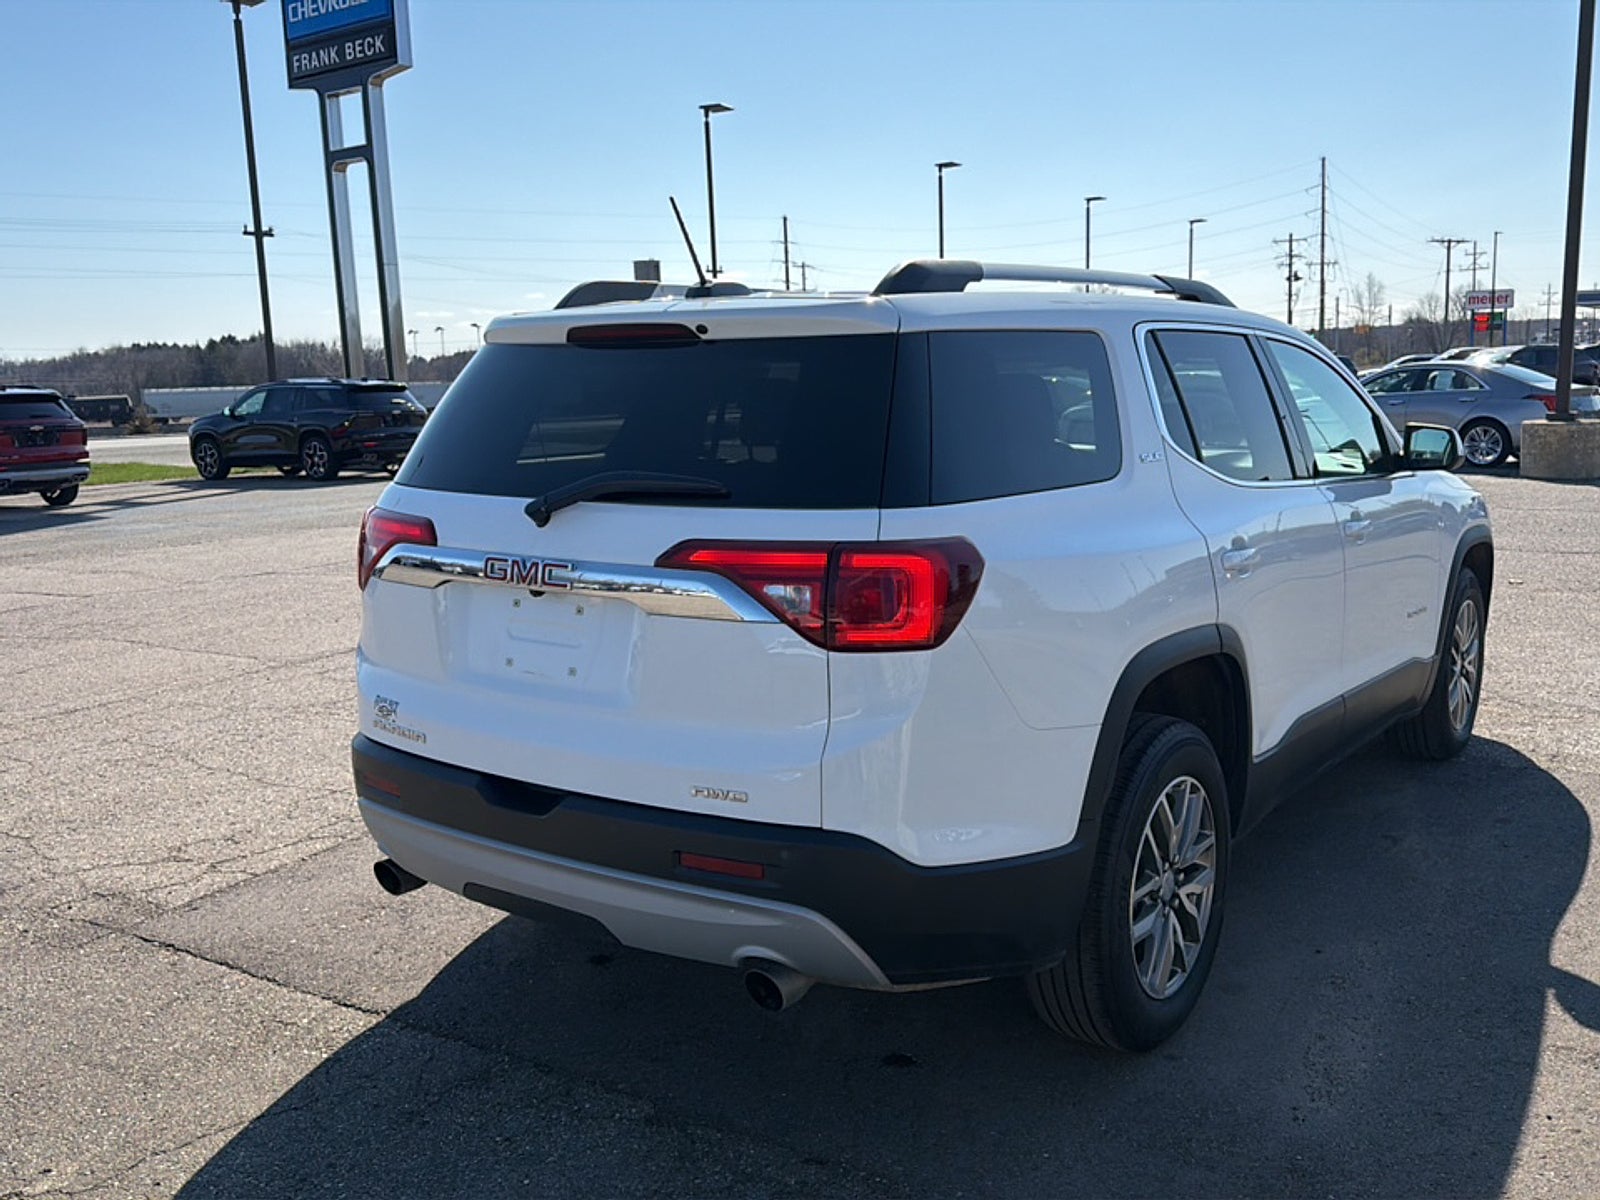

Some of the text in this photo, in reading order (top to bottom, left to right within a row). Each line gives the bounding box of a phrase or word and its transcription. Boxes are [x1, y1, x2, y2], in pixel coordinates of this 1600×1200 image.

[293, 34, 385, 73] FRANK BECK
[1468, 291, 1510, 305] meier
[484, 554, 573, 590] GMC
[690, 785, 749, 803] AWD
